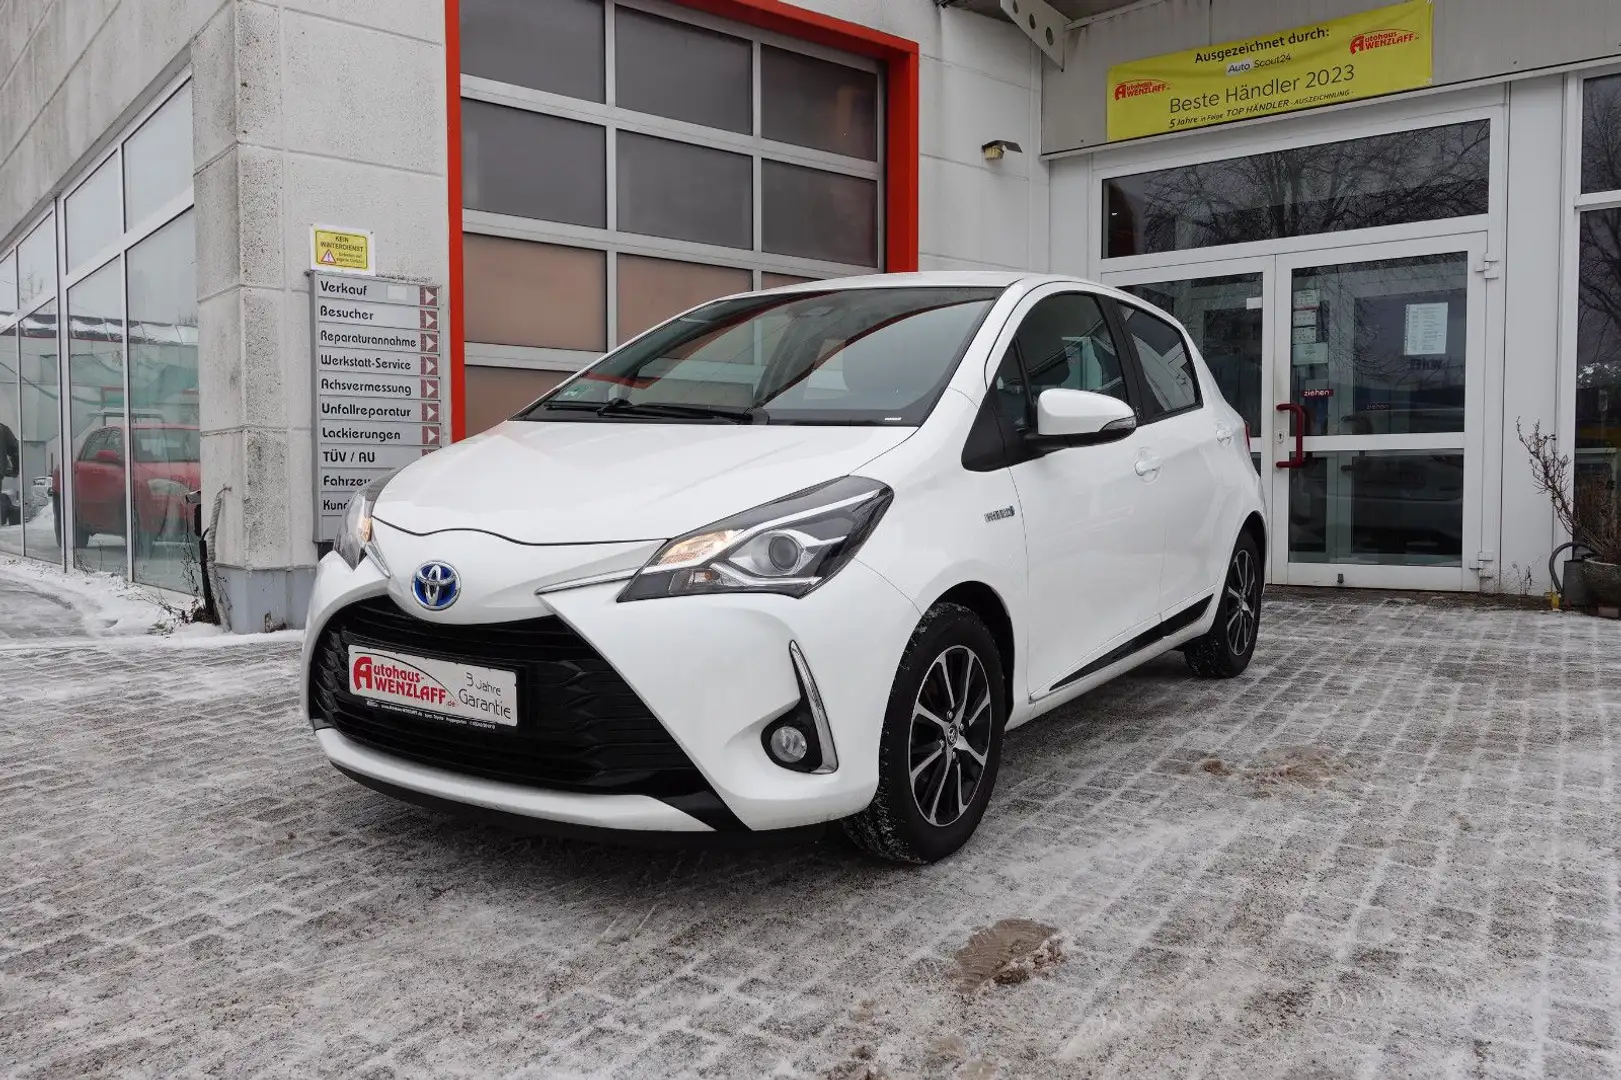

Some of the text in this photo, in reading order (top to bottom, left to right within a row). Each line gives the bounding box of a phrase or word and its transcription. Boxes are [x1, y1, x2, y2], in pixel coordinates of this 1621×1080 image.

[1195, 27, 1330, 63] Ausgezeichnet durch:
[1365, 33, 1414, 50] WENZLAFF
[1228, 53, 1291, 73] Auto Scout24
[1170, 63, 1355, 114] Beste Händler 2023
[1169, 118, 1177, 129] 5
[1177, 117, 1198, 126] Jahre
[1207, 113, 1224, 122] Folge
[1226, 108, 1245, 118] TOP
[1246, 99, 1289, 114] HÄNDLER
[320, 241, 364, 253] WINTERDIENST
[335, 235, 349, 244] KEIN
[320, 280, 368, 296] Verkauf
[320, 305, 374, 321] Besucher
[320, 330, 417, 347] Reparaturannahme
[320, 354, 412, 370] Werkstatt-Service
[321, 378, 412, 396] Achsvermessung
[1303, 388, 1331, 397] ziehen
[322, 403, 412, 418] Unfallreparatur
[322, 427, 401, 442] Lackierungen
[323, 449, 347, 463] TÜV
[358, 452, 376, 463] AU
[374, 675, 447, 705] WENZLAFF
[465, 672, 502, 697] 3 Jahre
[458, 688, 512, 720] Garantie
